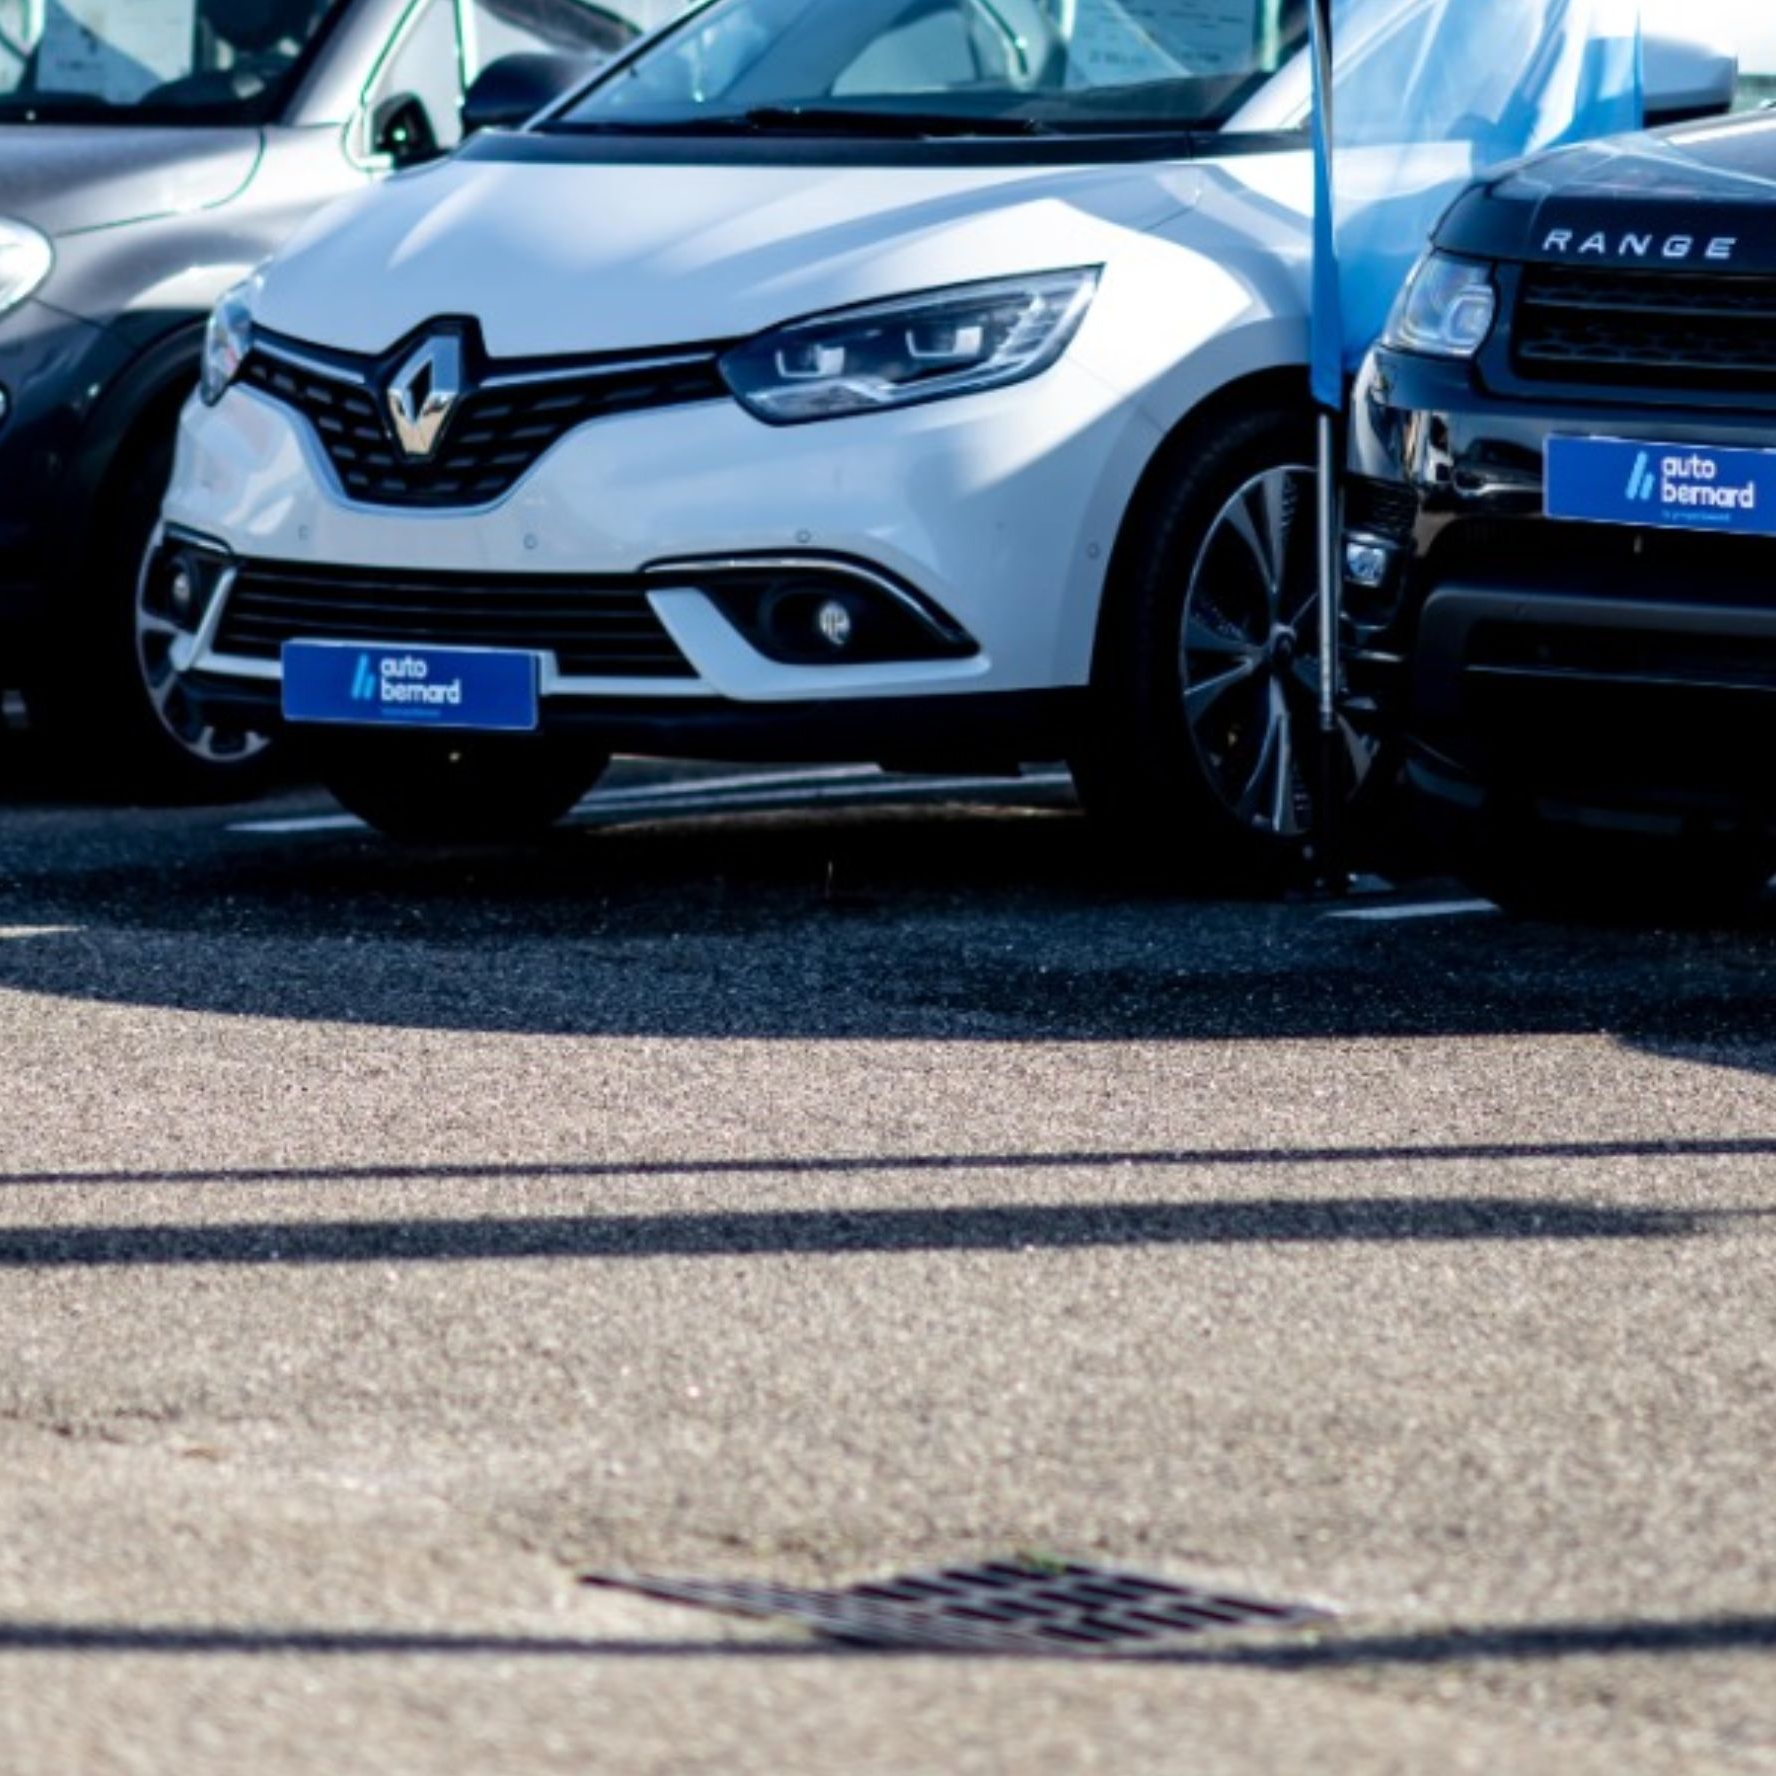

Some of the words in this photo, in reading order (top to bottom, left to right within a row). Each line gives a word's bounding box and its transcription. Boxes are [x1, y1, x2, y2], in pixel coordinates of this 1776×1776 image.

[1542, 229, 1737, 260] RANGE
[1661, 453, 1717, 480] auto
[1661, 477, 1755, 509] bernard
[381, 655, 428, 678] auto
[381, 677, 462, 704] bernard
